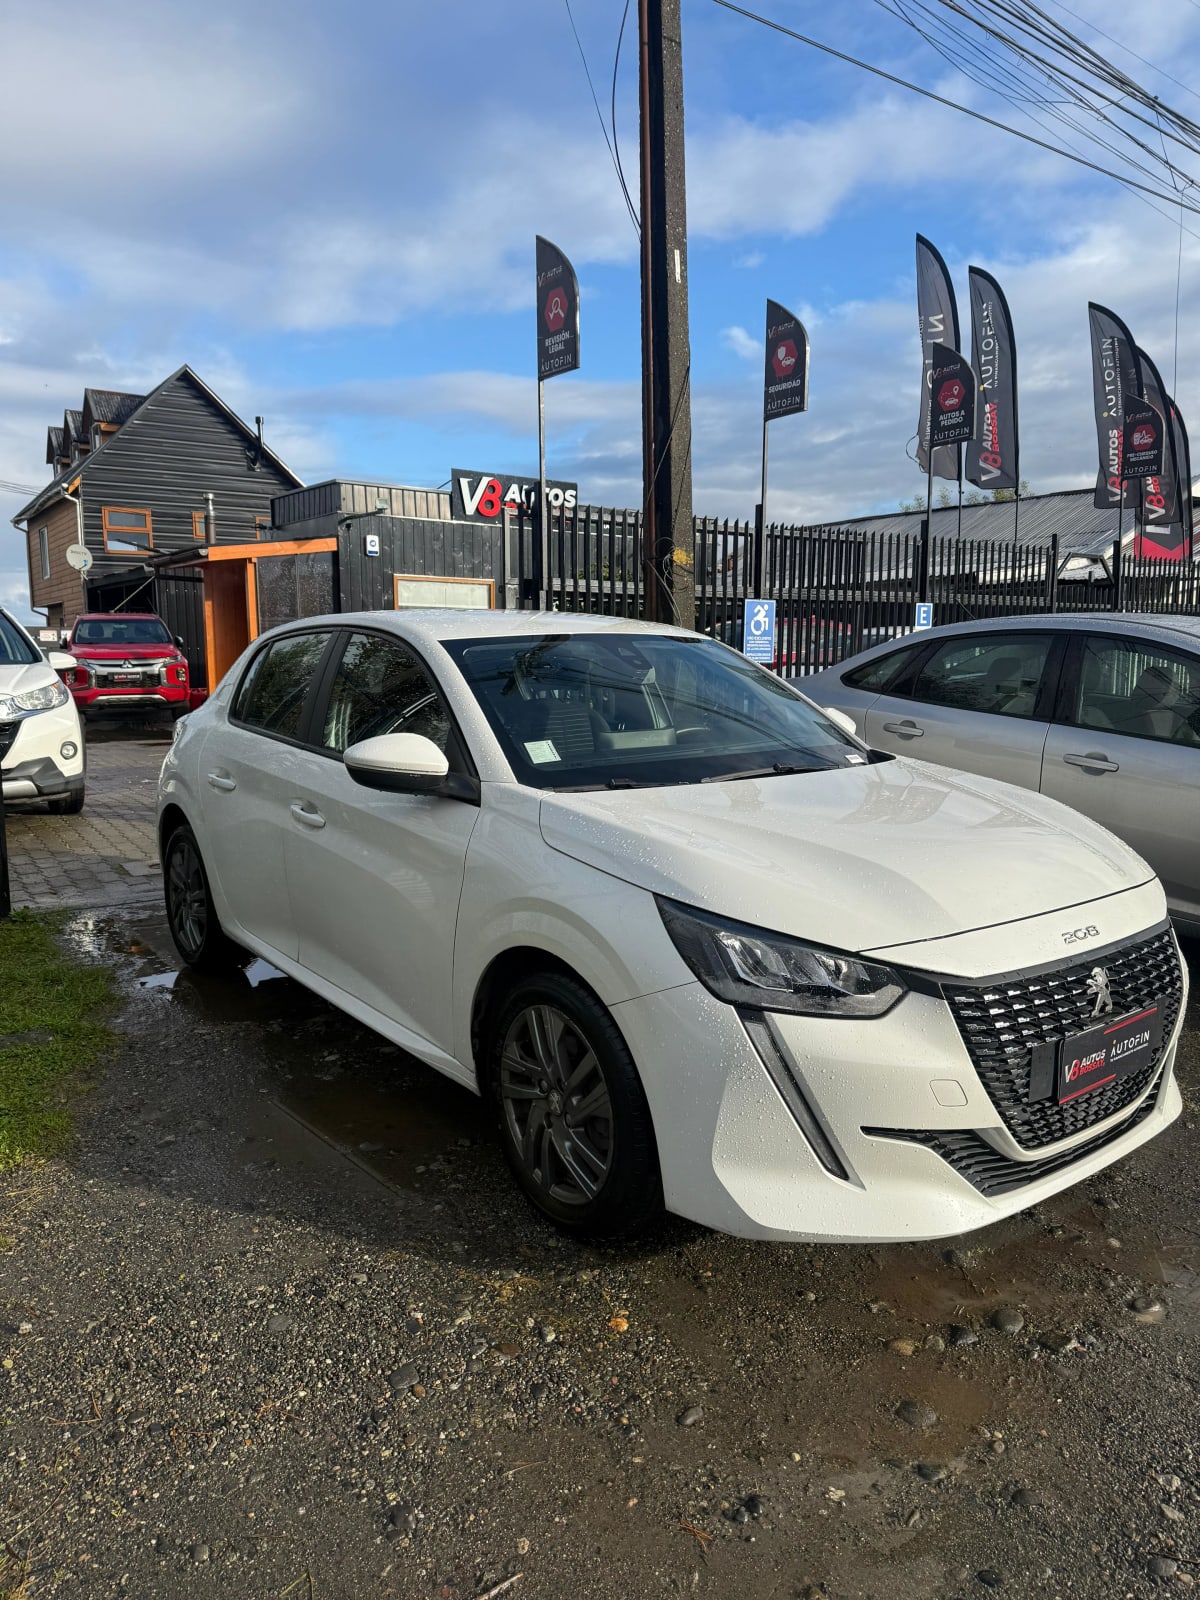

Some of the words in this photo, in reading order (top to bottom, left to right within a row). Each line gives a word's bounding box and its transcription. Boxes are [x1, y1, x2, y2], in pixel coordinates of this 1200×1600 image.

[545, 330, 570, 347] REVISIÓN
[548, 342, 565, 354] LEGAL
[541, 353, 572, 372] AUTOFIN
[768, 379, 800, 394] SEGURIDAD
[1102, 338, 1117, 417] AUTOFIN
[766, 395, 801, 410] AUTOFIN
[939, 412, 960, 422] AUTOS
[960, 410, 966, 418] A
[940, 416, 964, 427] PEDIDO
[933, 426, 970, 441] AUTOFIN
[982, 403, 993, 451] AUTOS
[990, 403, 1000, 452] BOSSAY
[1108, 429, 1118, 475] AUTOS
[979, 452, 1002, 481] V8
[1124, 465, 1158, 474] AUTOFIN
[459, 476, 502, 517] V8
[503, 483, 577, 508] AUOS
[1145, 494, 1166, 520] V8
[919, 607, 928, 623] E
[1061, 925, 1100, 945] 208
[1110, 1030, 1150, 1056] AUTOFIN
[1064, 1059, 1080, 1084] V8
[1080, 1049, 1106, 1068] AUTOS
